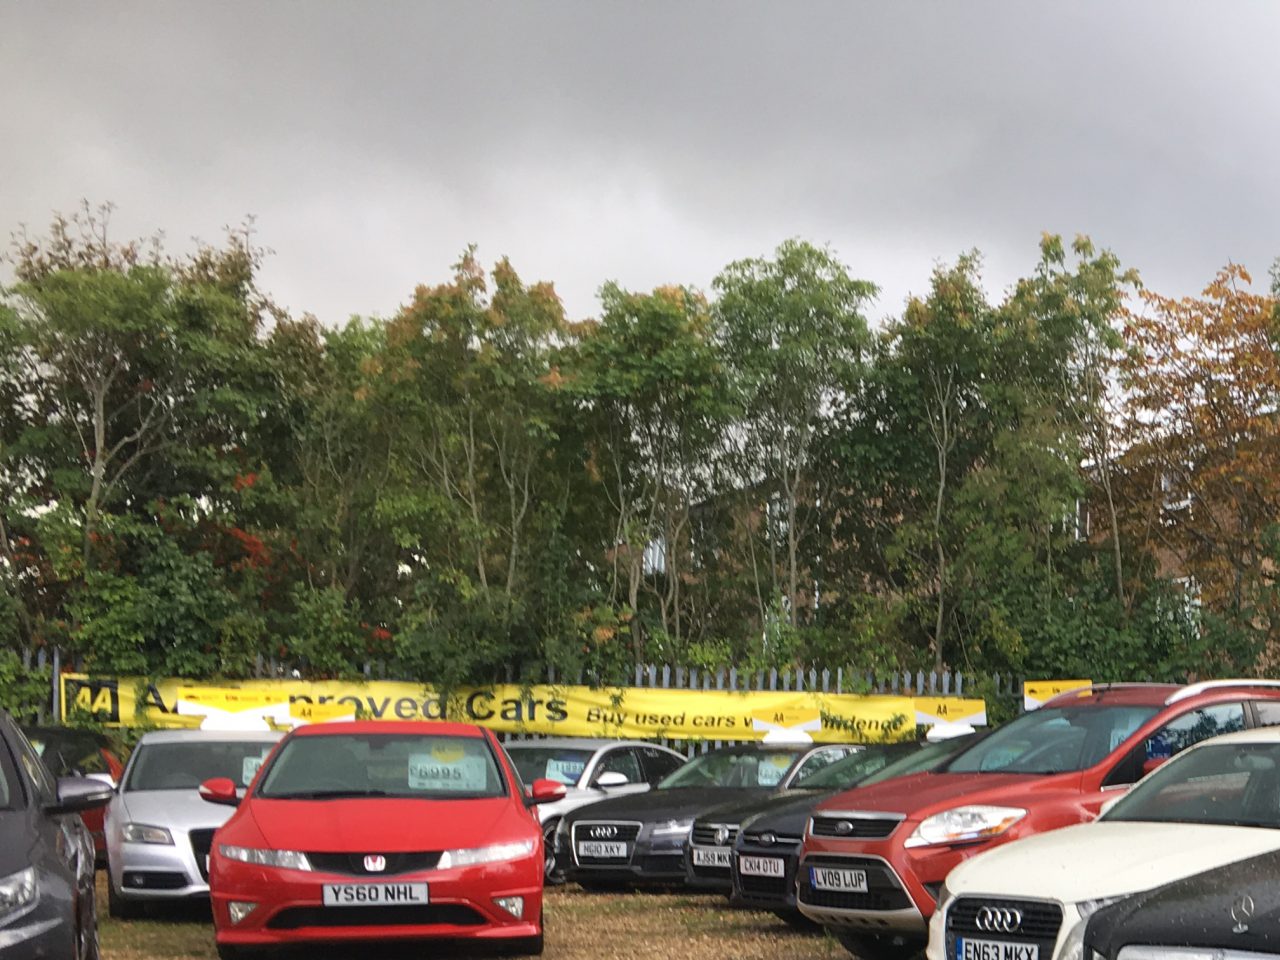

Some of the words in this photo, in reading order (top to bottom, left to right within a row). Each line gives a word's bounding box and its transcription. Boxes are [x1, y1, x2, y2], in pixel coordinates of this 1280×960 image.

[75, 686, 113, 714] AA
[465, 690, 569, 722] Cars
[586, 707, 627, 727] Buy
[635, 711, 686, 727] used
[692, 714, 736, 728] cars
[816, 870, 841, 888] LV09
[843, 872, 865, 889] LUP
[331, 885, 379, 901] YS60
[384, 884, 420, 901] NHL
